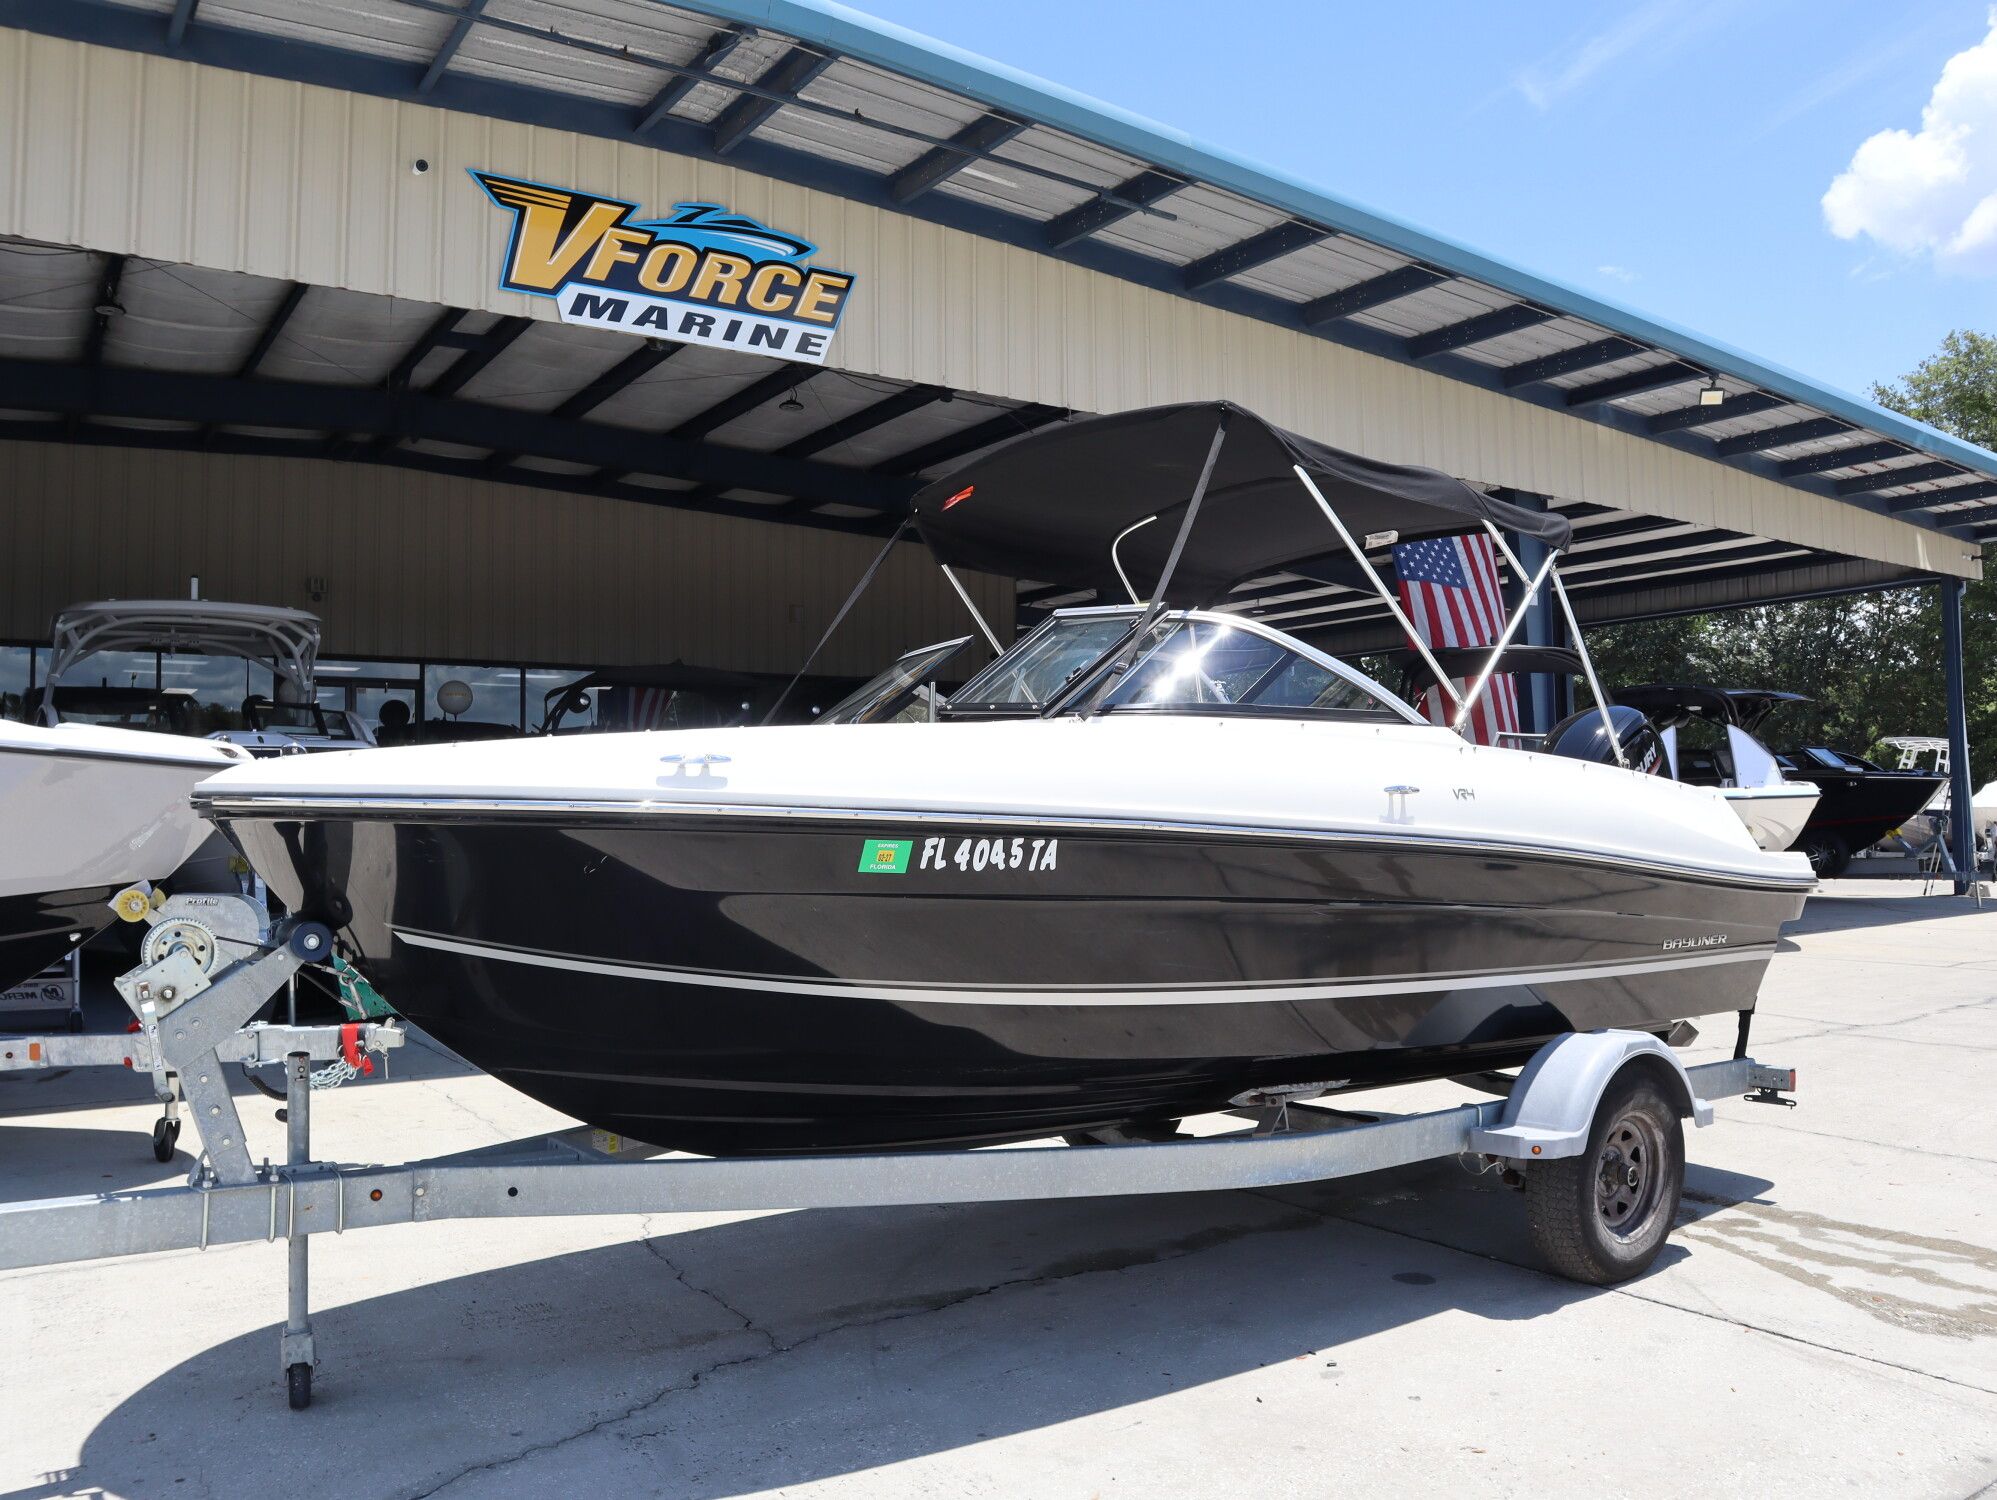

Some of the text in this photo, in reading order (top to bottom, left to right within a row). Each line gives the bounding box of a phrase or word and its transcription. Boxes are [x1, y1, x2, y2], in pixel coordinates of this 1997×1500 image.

[568, 293, 828, 357] MARINE
[920, 837, 1058, 871] FL 4045 TA
[1662, 934, 1728, 950] BAYLINER
